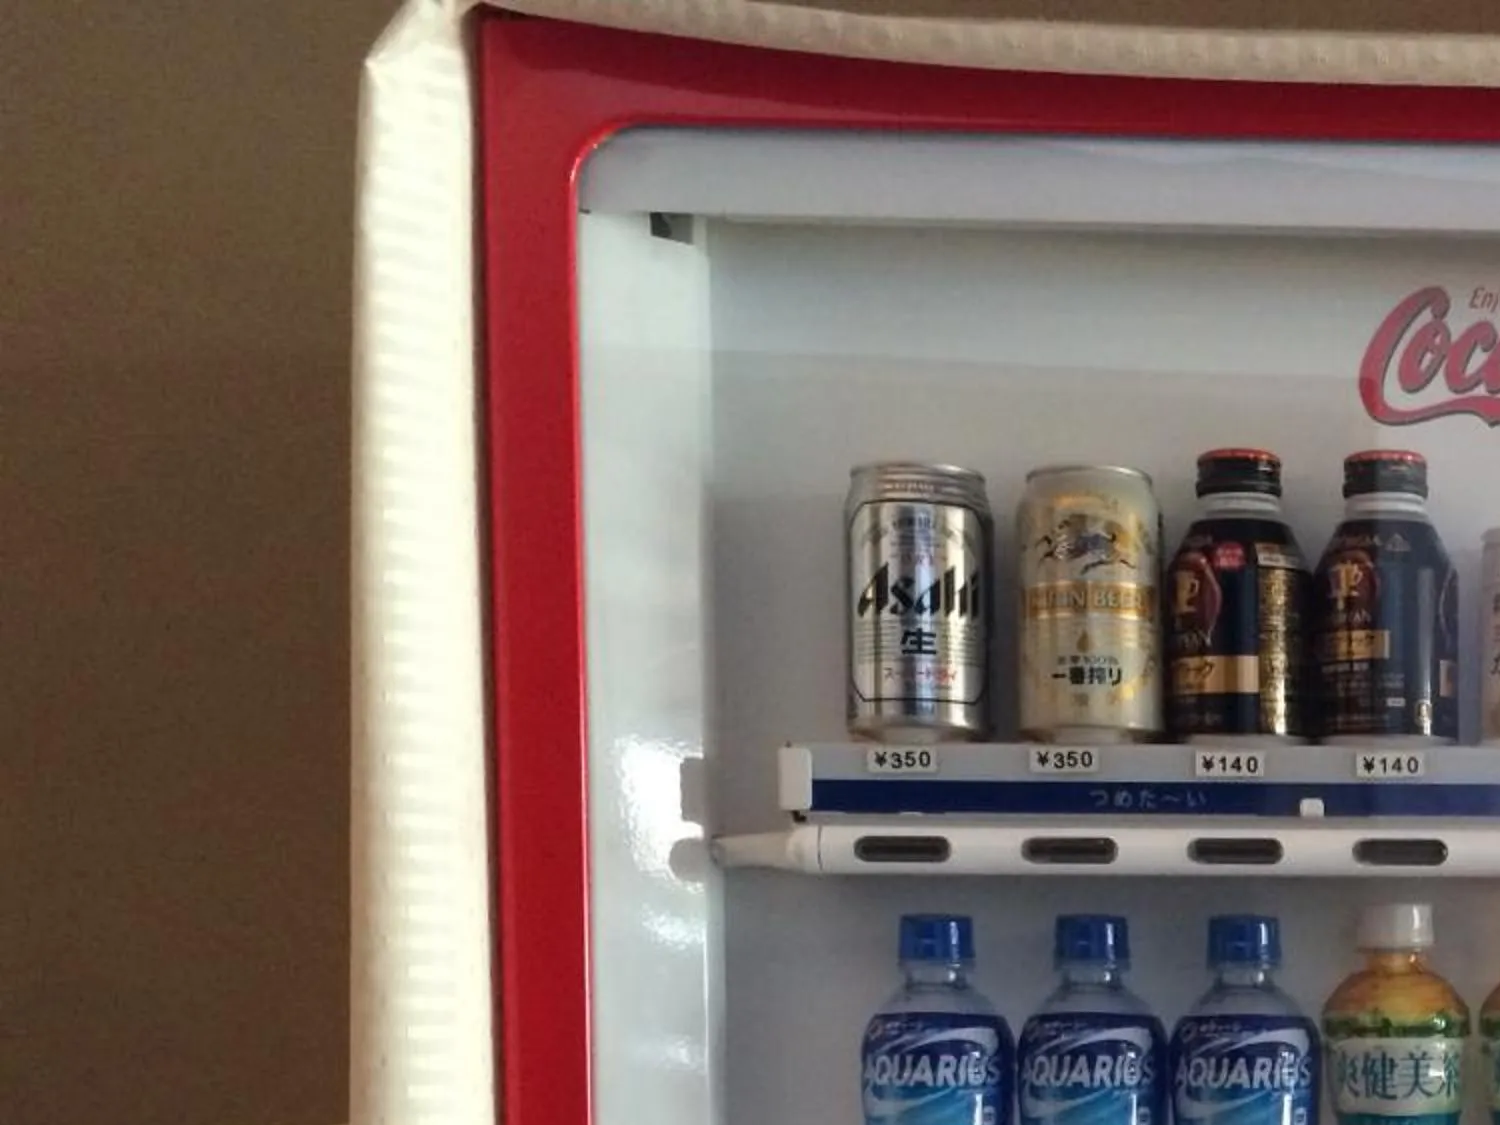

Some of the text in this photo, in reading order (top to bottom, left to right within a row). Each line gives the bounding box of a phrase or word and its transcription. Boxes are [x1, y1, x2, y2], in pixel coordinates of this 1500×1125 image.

[858, 562, 978, 617] Asahi
[902, 628, 937, 655] 生
[874, 750, 931, 769] ¥350
[1037, 750, 1093, 769] ¥350
[1202, 755, 1259, 774] ¥140
[1363, 756, 1419, 774] ¥140
[865, 1054, 1000, 1087] AQUARIUS
[1022, 1054, 1154, 1087] AQUARIUS
[1176, 1054, 1312, 1087] AQUARIUS
